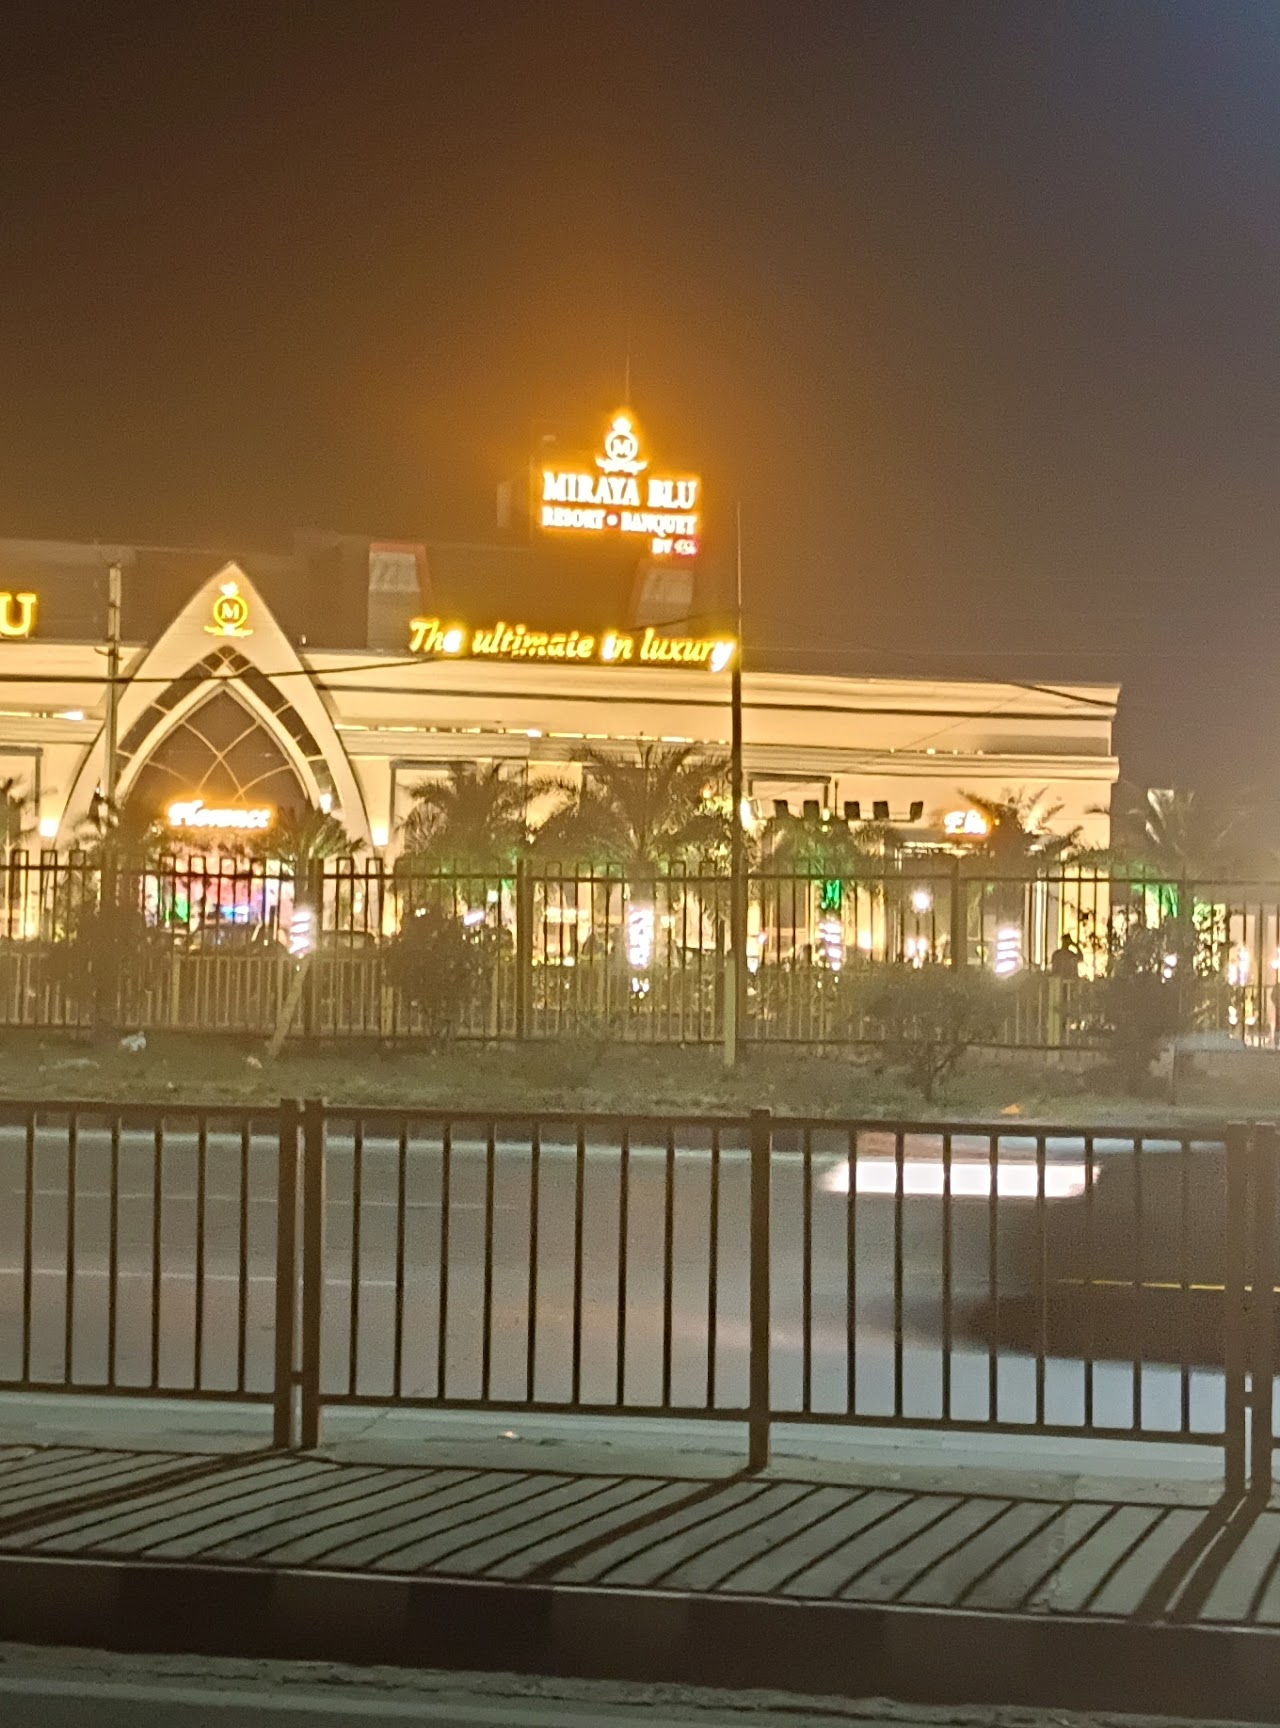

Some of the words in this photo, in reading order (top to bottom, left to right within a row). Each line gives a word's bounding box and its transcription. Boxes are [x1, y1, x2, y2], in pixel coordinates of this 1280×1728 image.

[543, 472, 640, 506] MIRAYA
[647, 479, 698, 509] BLU
[620, 512, 698, 537] BANQUET
[409, 617, 463, 653] The
[472, 620, 596, 659] ultimate
[602, 630, 633, 661] in
[639, 627, 736, 673] luxury
